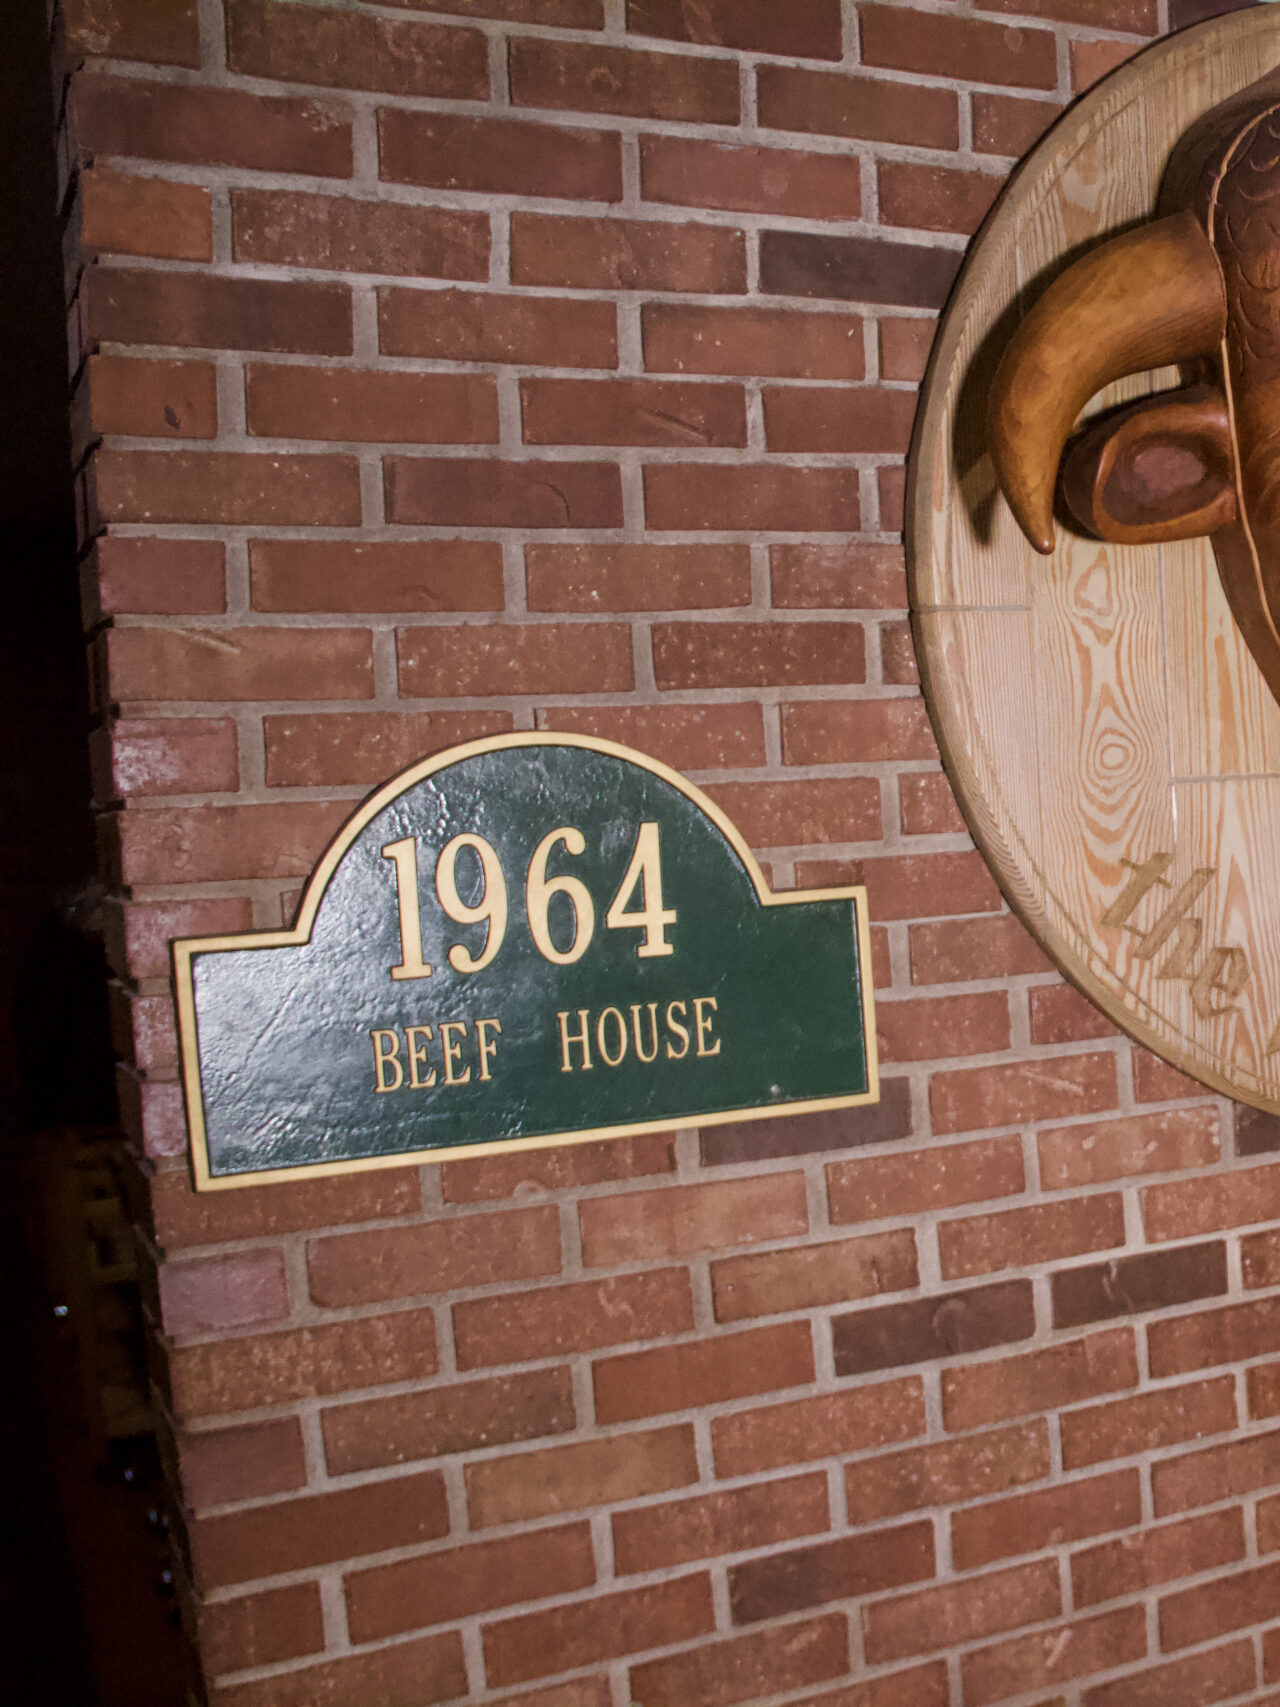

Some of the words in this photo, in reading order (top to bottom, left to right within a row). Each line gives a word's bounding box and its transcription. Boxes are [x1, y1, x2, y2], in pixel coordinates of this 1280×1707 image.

[380, 821, 677, 980] 1964
[369, 1017, 503, 1094] BEEF
[556, 996, 722, 1073] HOUSE
